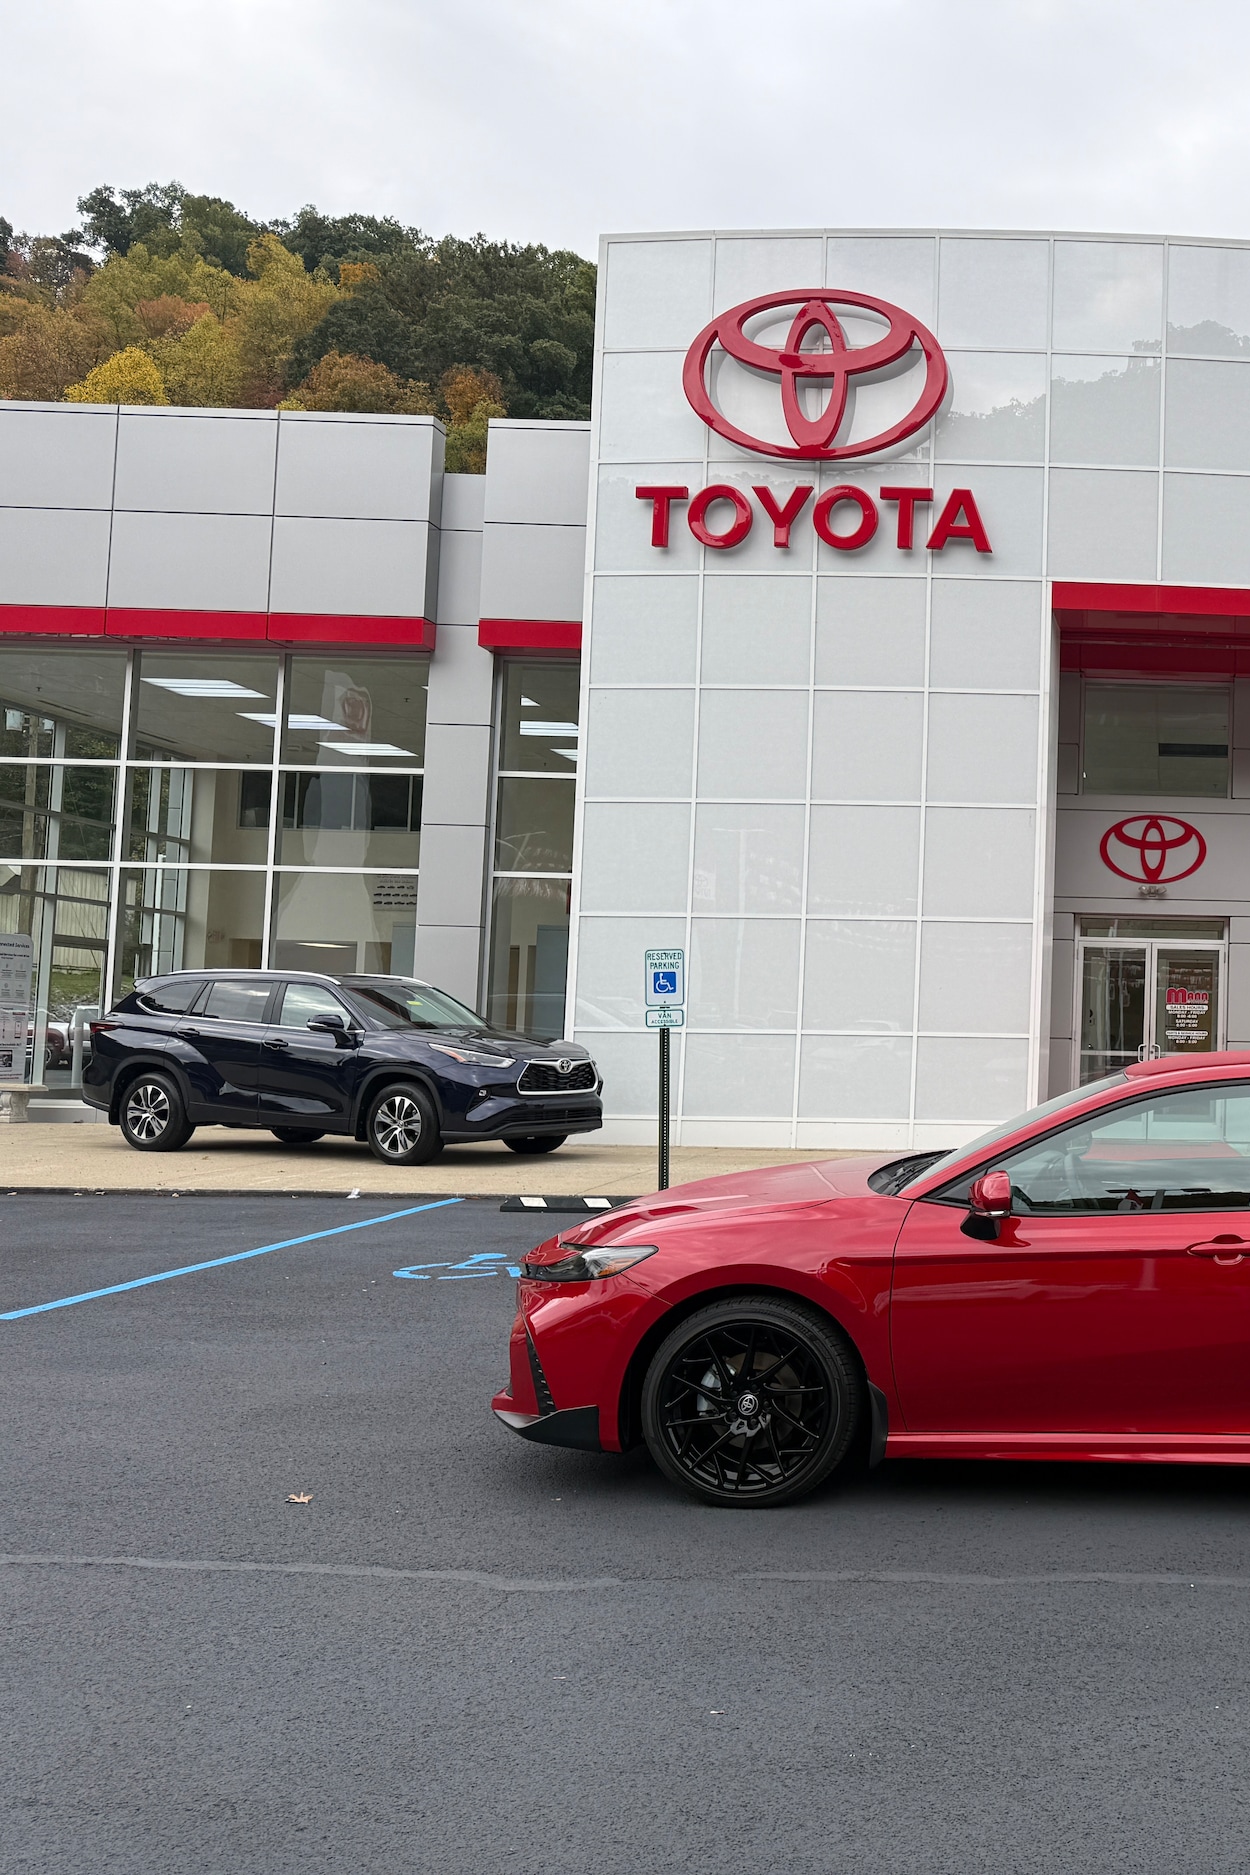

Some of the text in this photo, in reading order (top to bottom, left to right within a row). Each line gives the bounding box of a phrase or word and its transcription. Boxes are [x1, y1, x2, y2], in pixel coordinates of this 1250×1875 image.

[635, 484, 992, 553] TOYOTA
[647, 952, 682, 961] RESERVED
[650, 961, 680, 970] PARKING
